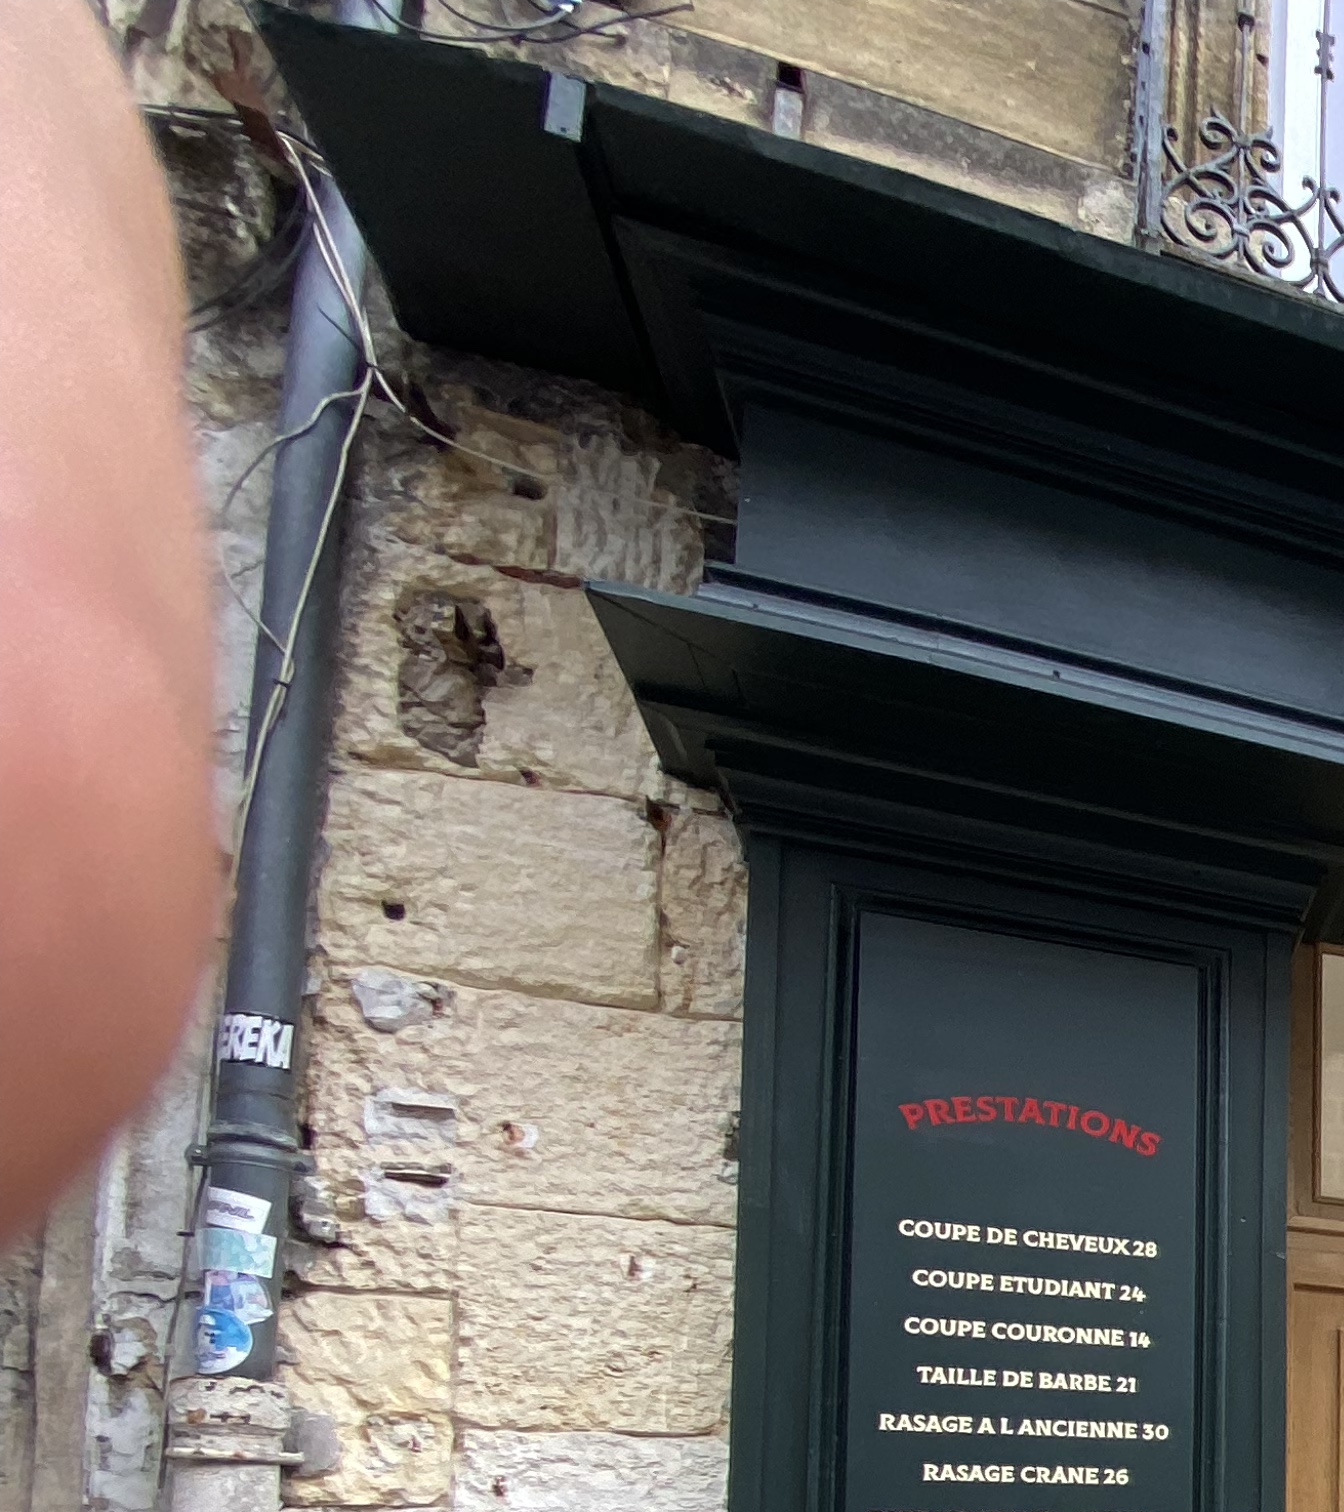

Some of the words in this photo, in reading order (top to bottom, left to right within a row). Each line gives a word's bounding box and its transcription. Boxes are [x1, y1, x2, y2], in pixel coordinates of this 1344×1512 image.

[898, 1095, 1163, 1156] PRESTATIONS
[898, 1218, 981, 1244] COUPE
[986, 1226, 1018, 1246] DE
[1022, 1229, 1131, 1257] CHEVEUX
[1132, 1240, 1158, 1259] 28
[911, 1268, 994, 1292] COUPE
[999, 1274, 1115, 1300] ETUDIANT
[1118, 1284, 1147, 1302] 24
[903, 1316, 986, 1339] COUPE
[991, 1321, 1125, 1347] COURONNE
[1128, 1331, 1151, 1349] 14
[915, 1365, 997, 1387] TAILLE
[1002, 1370, 1034, 1389] DE
[1038, 1372, 1112, 1393] BARBE
[1115, 1376, 1138, 1393] 21
[878, 1413, 973, 1434] RASAGE
[976, 1417, 996, 1435] A
[1000, 1417, 1014, 1435] L
[1016, 1419, 1138, 1439] ANCIENNE
[1141, 1424, 1169, 1441] 30
[922, 1463, 1016, 1483] RASAGE
[1019, 1466, 1100, 1485] CRANE
[1102, 1468, 1130, 1486] 26
